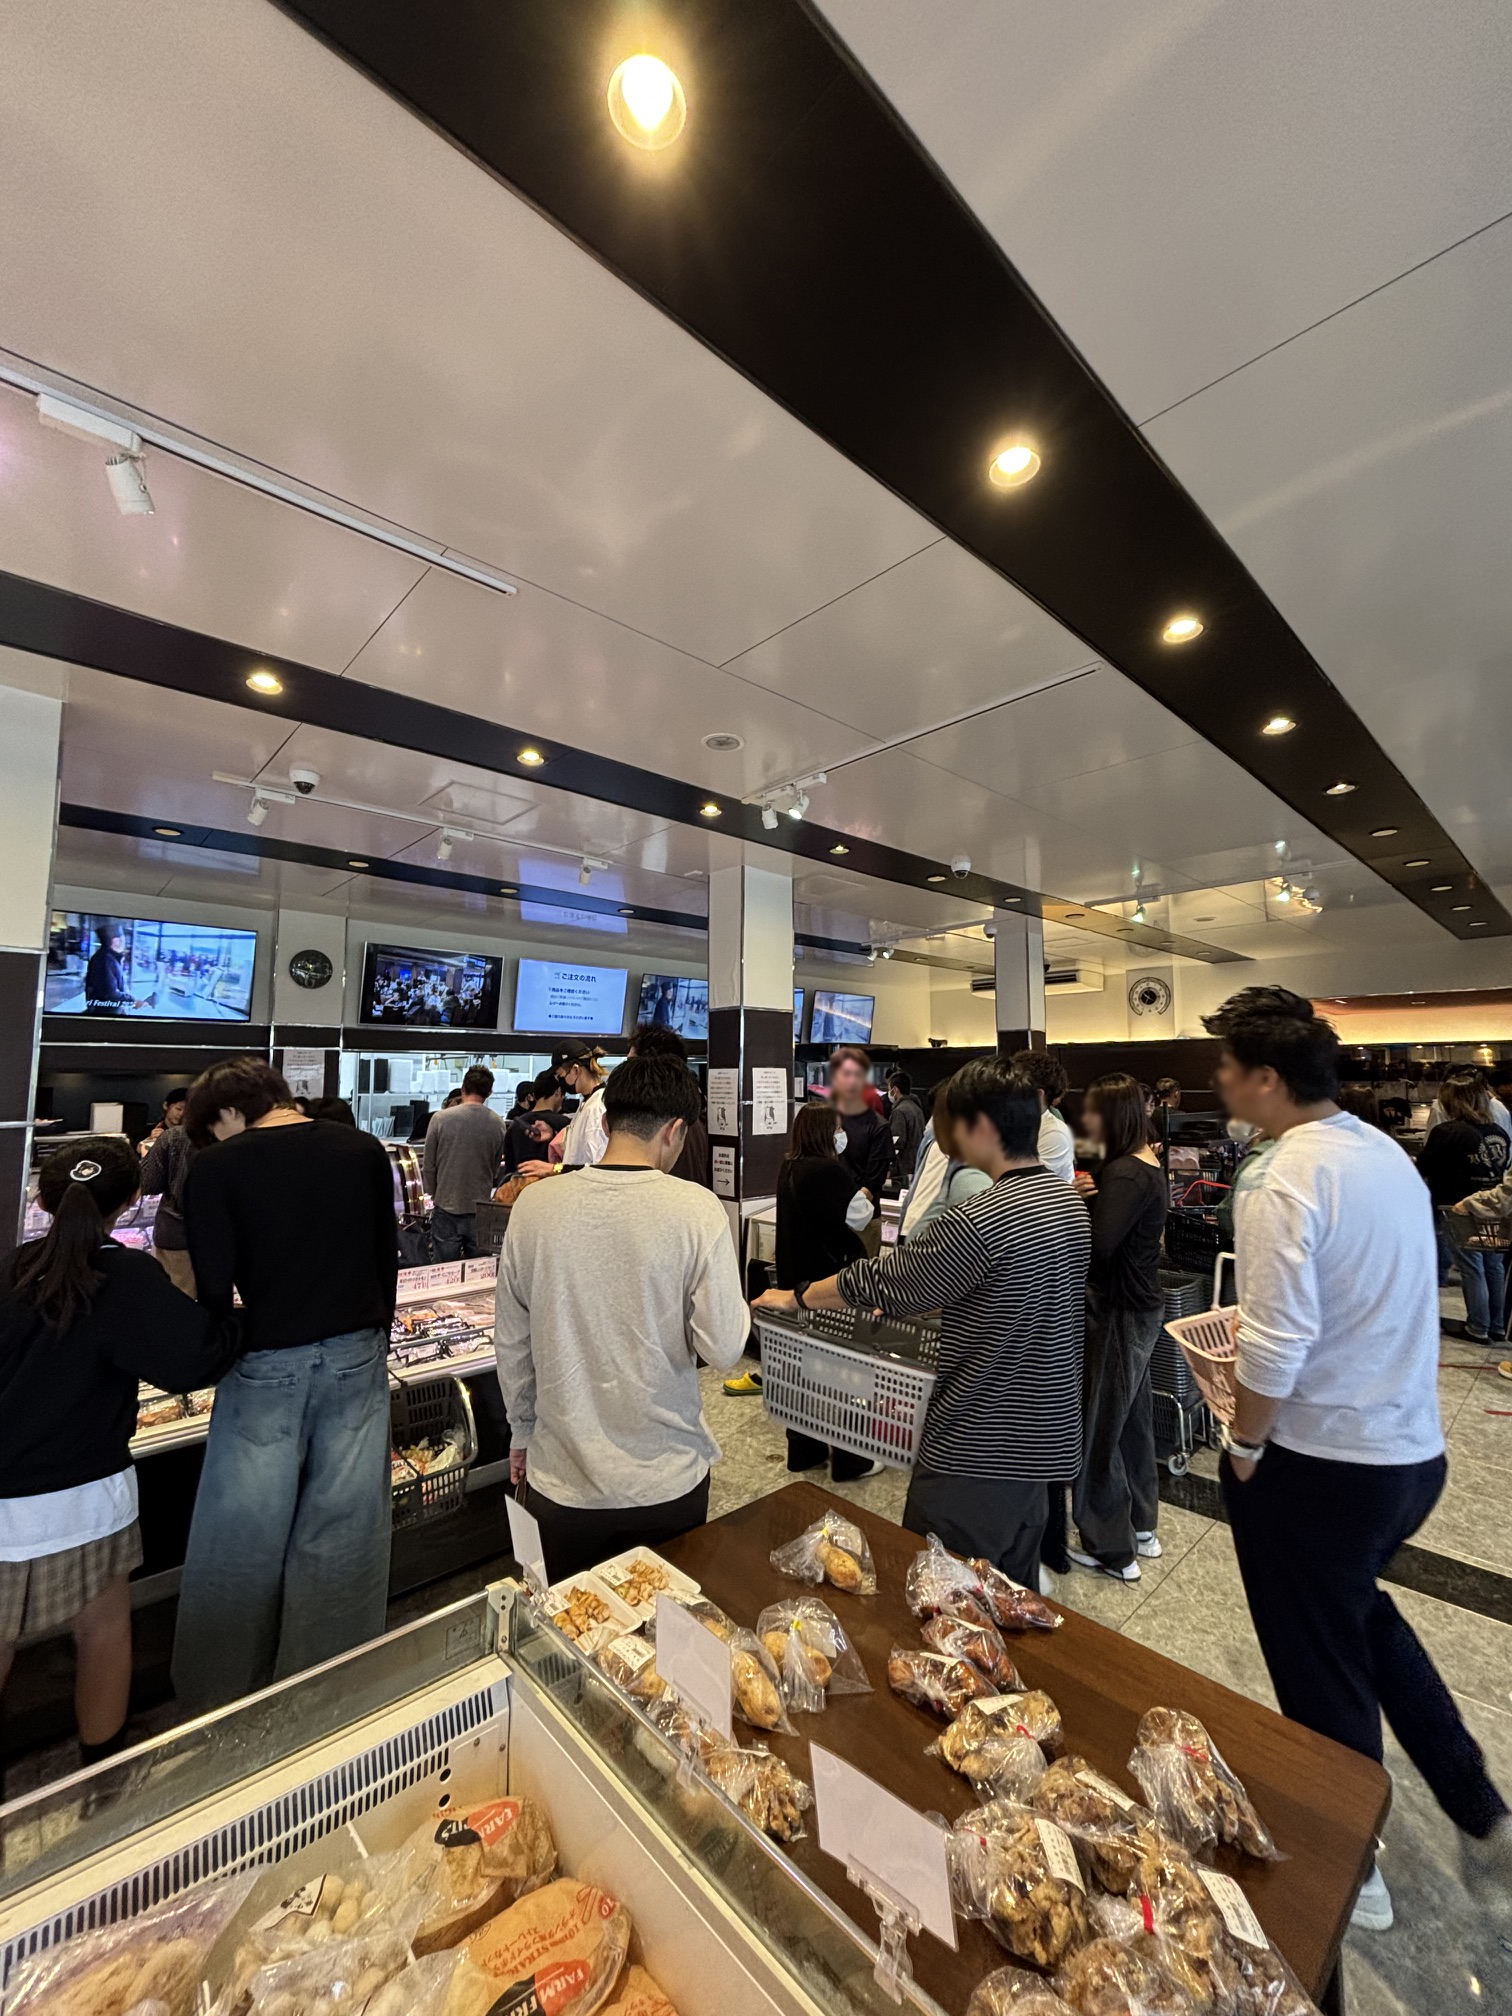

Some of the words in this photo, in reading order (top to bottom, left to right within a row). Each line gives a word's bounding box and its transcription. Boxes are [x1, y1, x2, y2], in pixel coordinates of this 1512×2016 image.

[561, 973, 597, 983] ご注文の流れ
[93, 999, 121, 1007] Festival
[601, 1897, 614, 1917] 10
[540, 1968, 585, 2003] FARM
